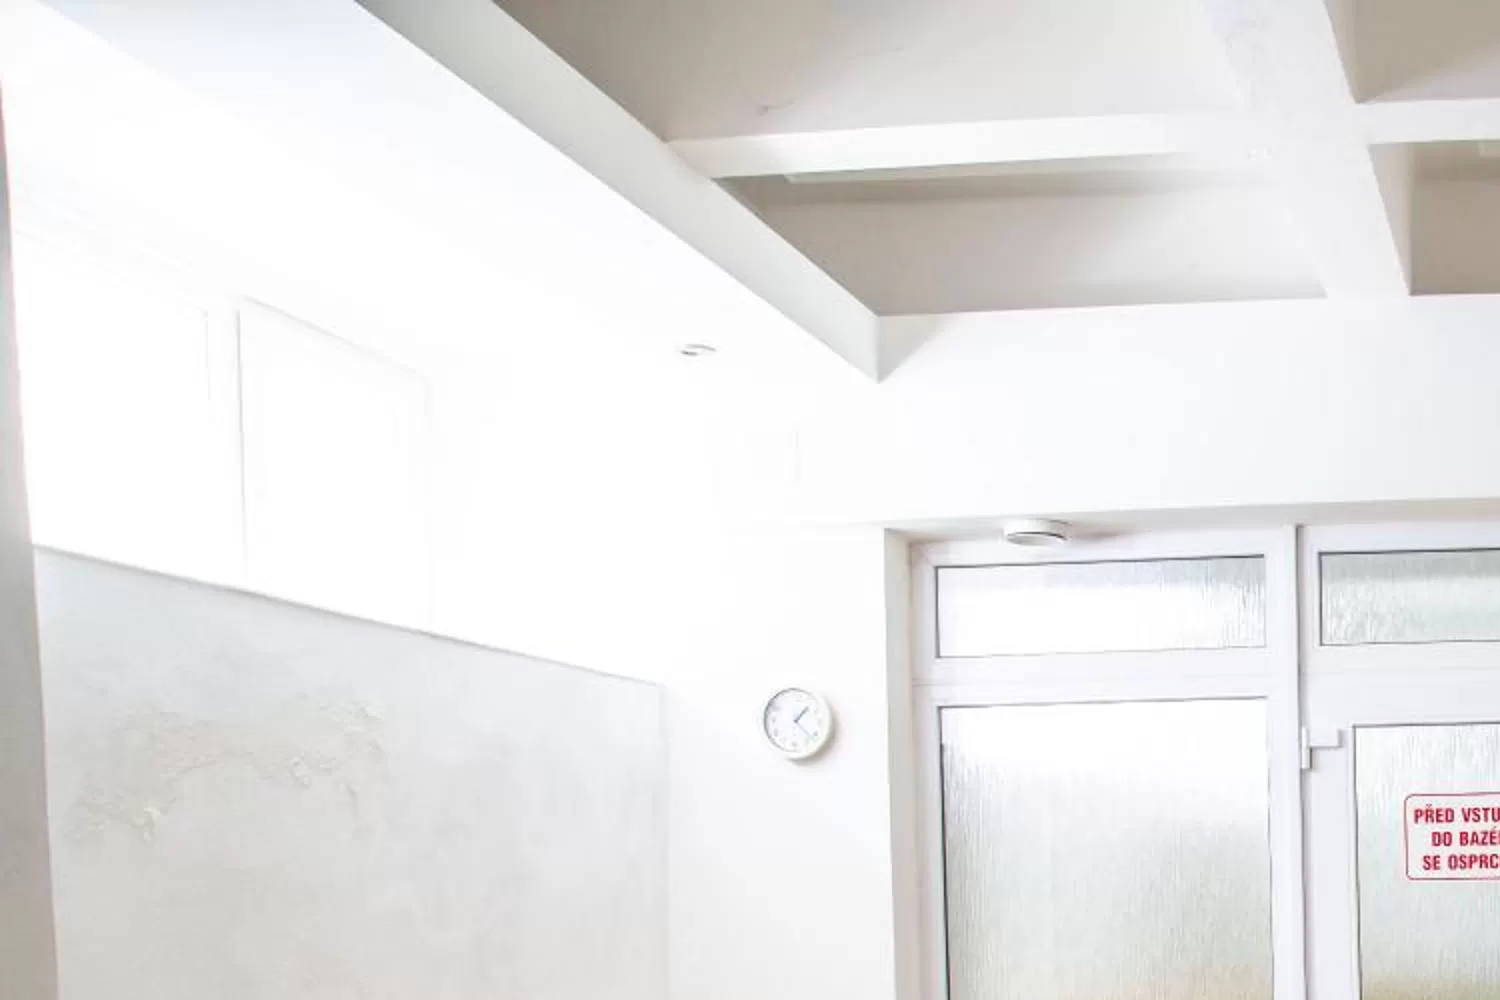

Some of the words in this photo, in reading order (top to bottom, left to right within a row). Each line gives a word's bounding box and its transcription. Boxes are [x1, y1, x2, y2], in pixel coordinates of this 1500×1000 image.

[1414, 804, 1455, 824] PŘED
[1431, 831, 1453, 847] DO
[1423, 855, 1441, 871] SE
